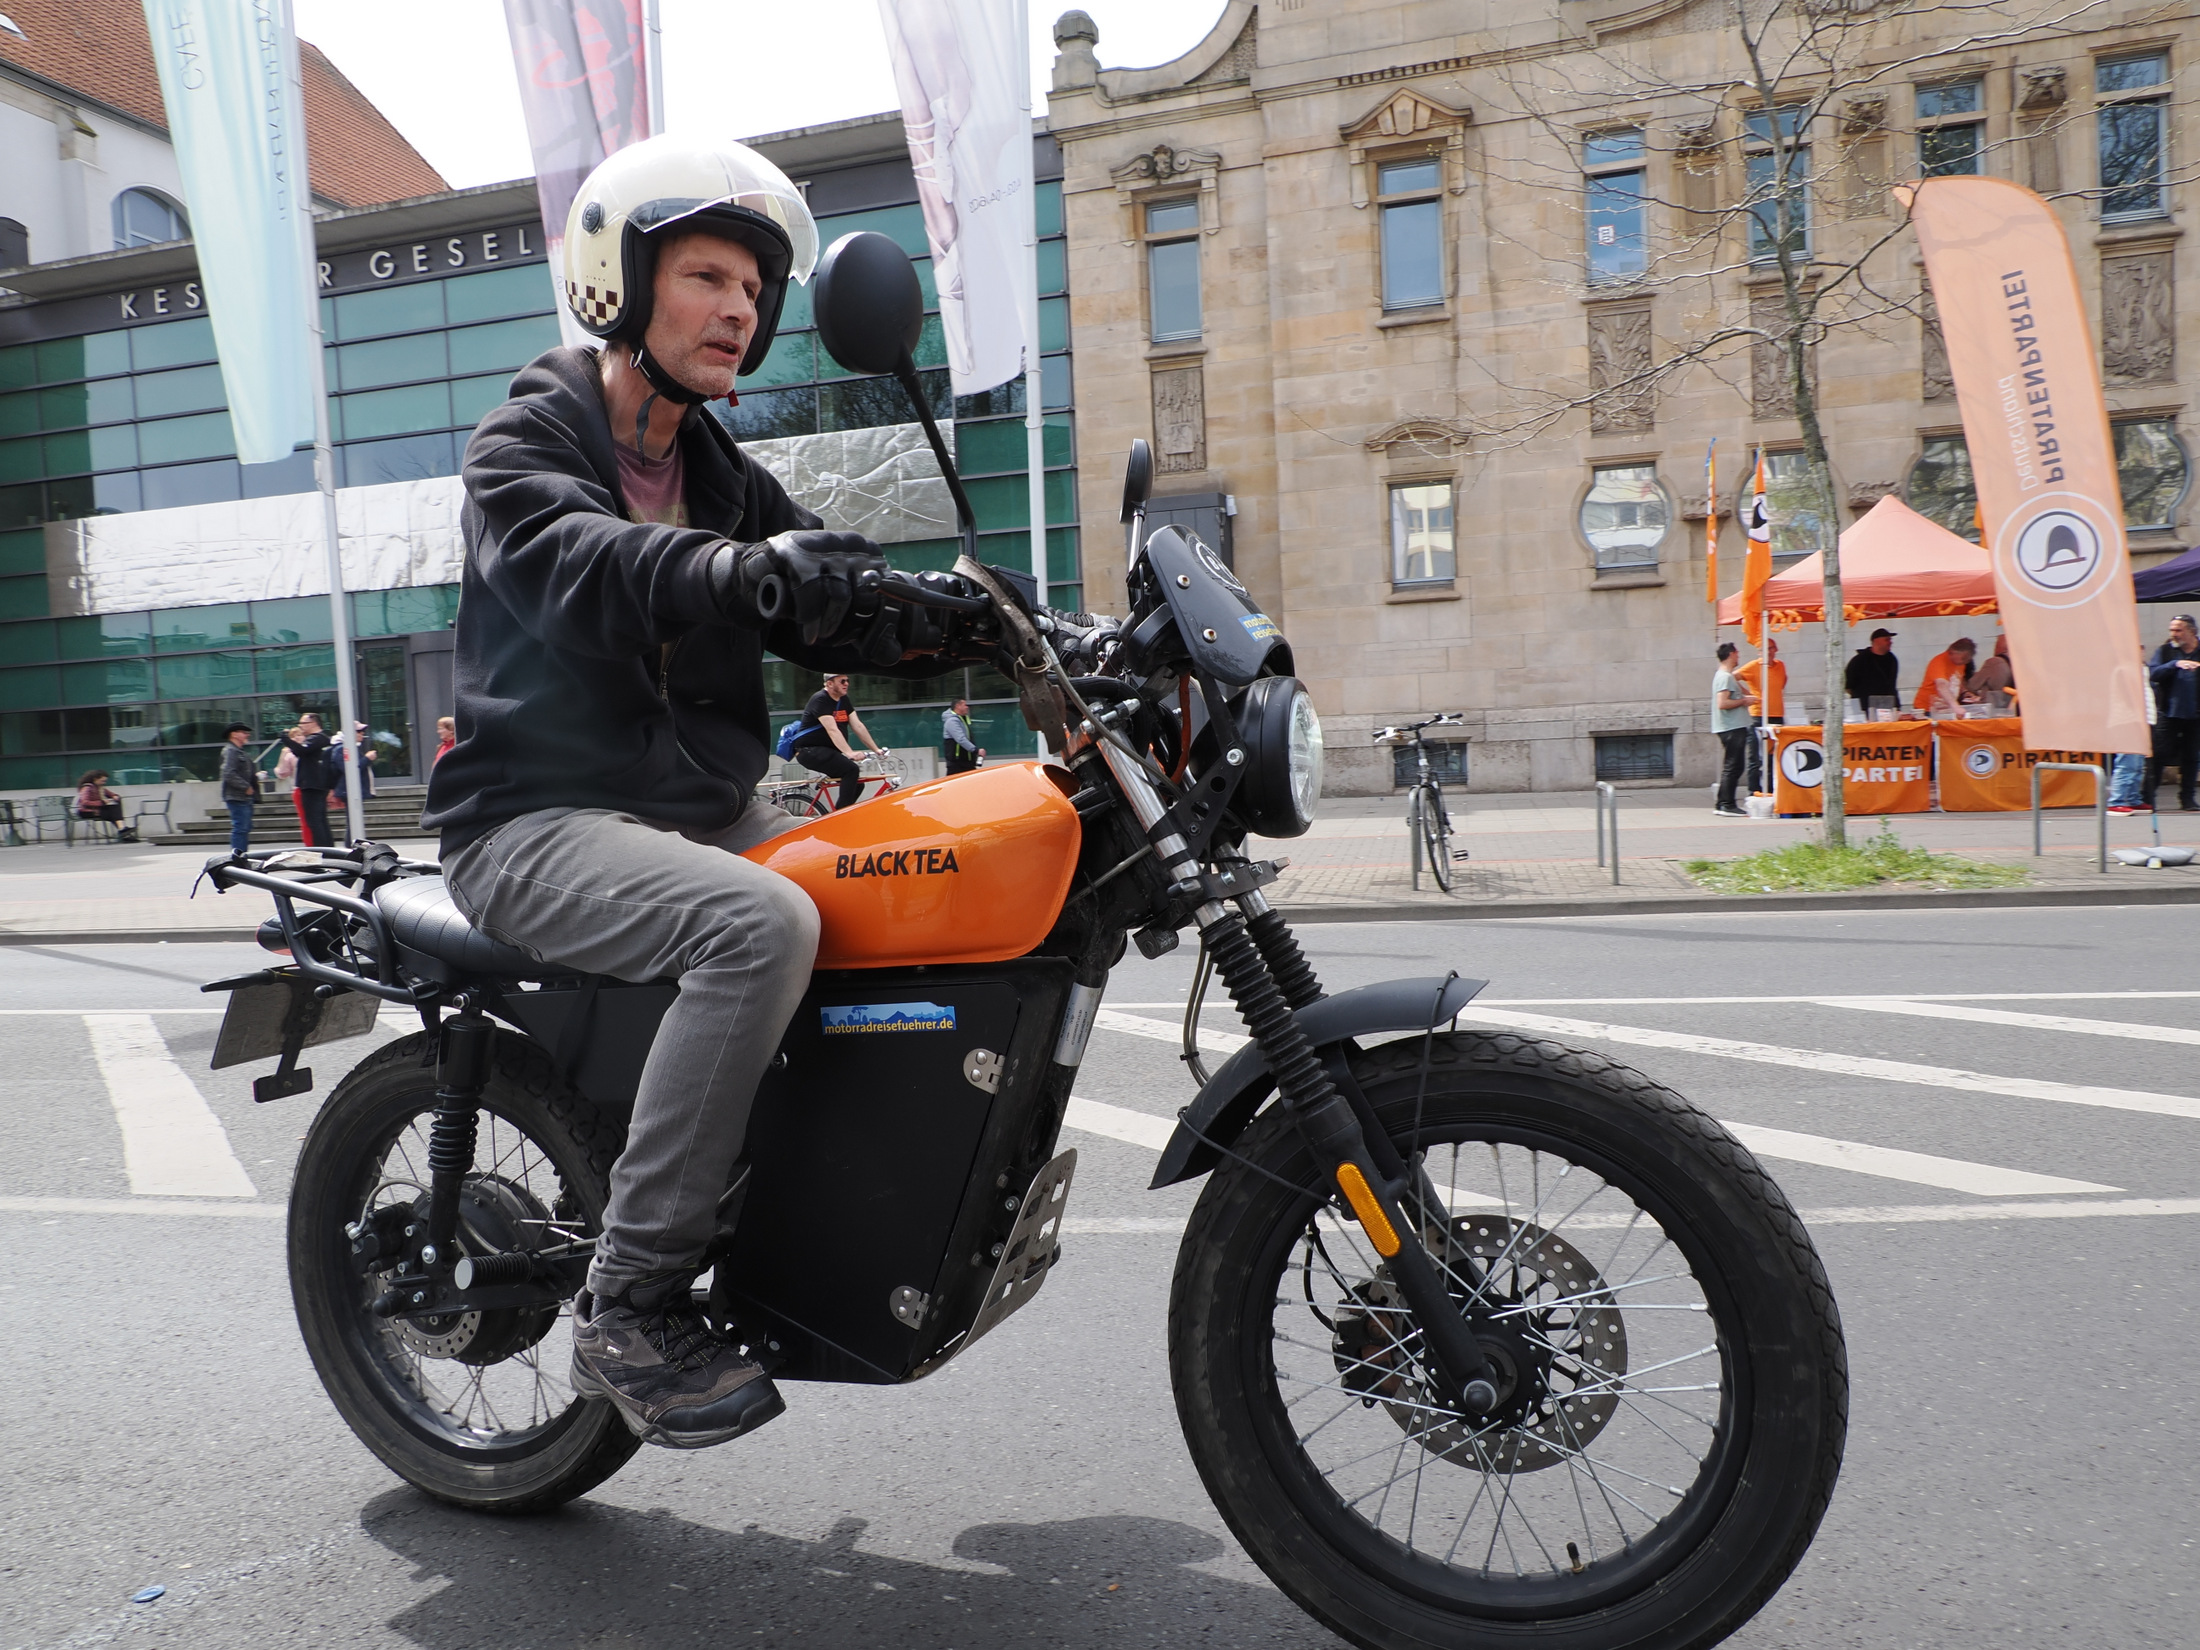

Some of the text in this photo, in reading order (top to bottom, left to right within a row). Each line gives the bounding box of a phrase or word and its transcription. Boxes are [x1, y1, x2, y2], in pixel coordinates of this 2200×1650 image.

[835, 848, 959, 879] BLACK TEA
[825, 1018, 954, 1034] motorradreisefuehrer.de
